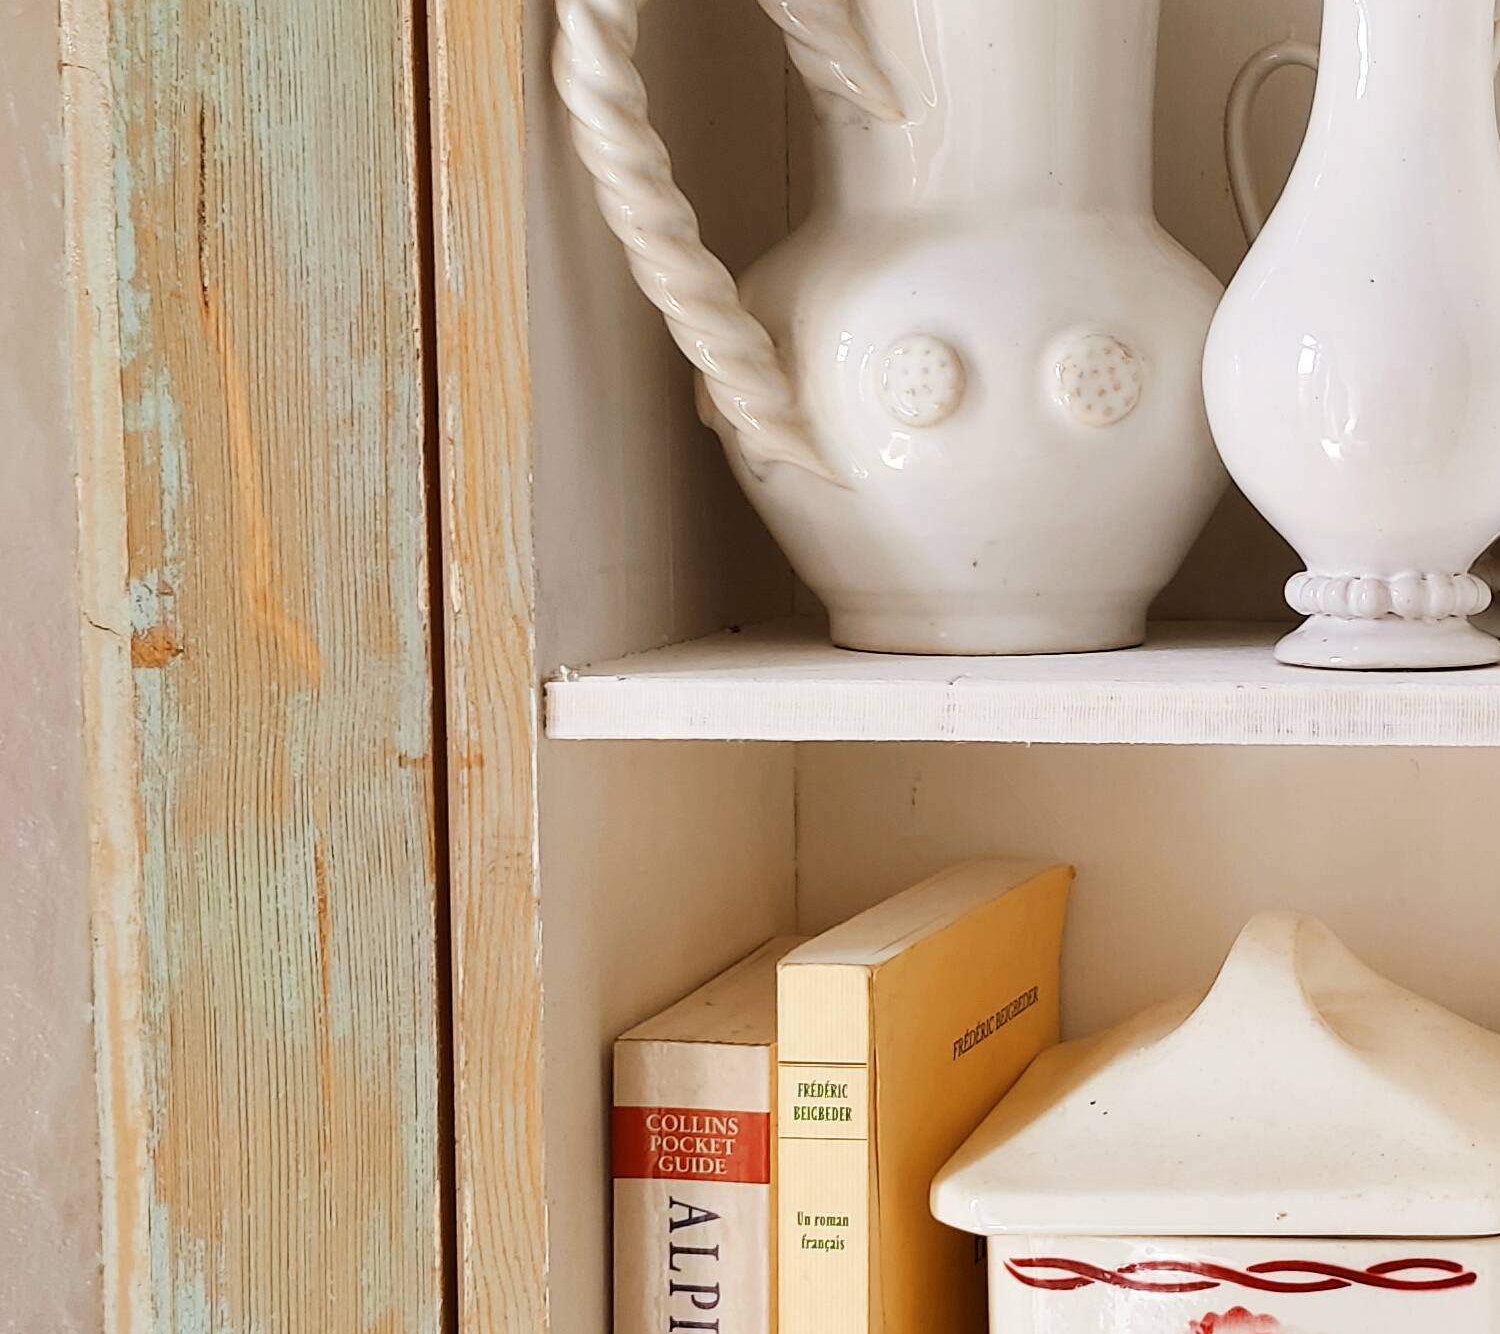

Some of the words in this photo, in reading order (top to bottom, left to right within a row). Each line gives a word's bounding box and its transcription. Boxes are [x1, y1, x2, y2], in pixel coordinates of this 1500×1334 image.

[797, 1080, 848, 1098] FRÉDÉRIC
[793, 1106, 852, 1121] BEIGBEDER
[646, 1112, 739, 1136] COLLINS
[649, 1136, 736, 1155] POCKET
[658, 1155, 728, 1176] GUIDE
[797, 1211, 811, 1226] Un
[814, 1216, 849, 1226] roman
[801, 1233, 845, 1252] français
